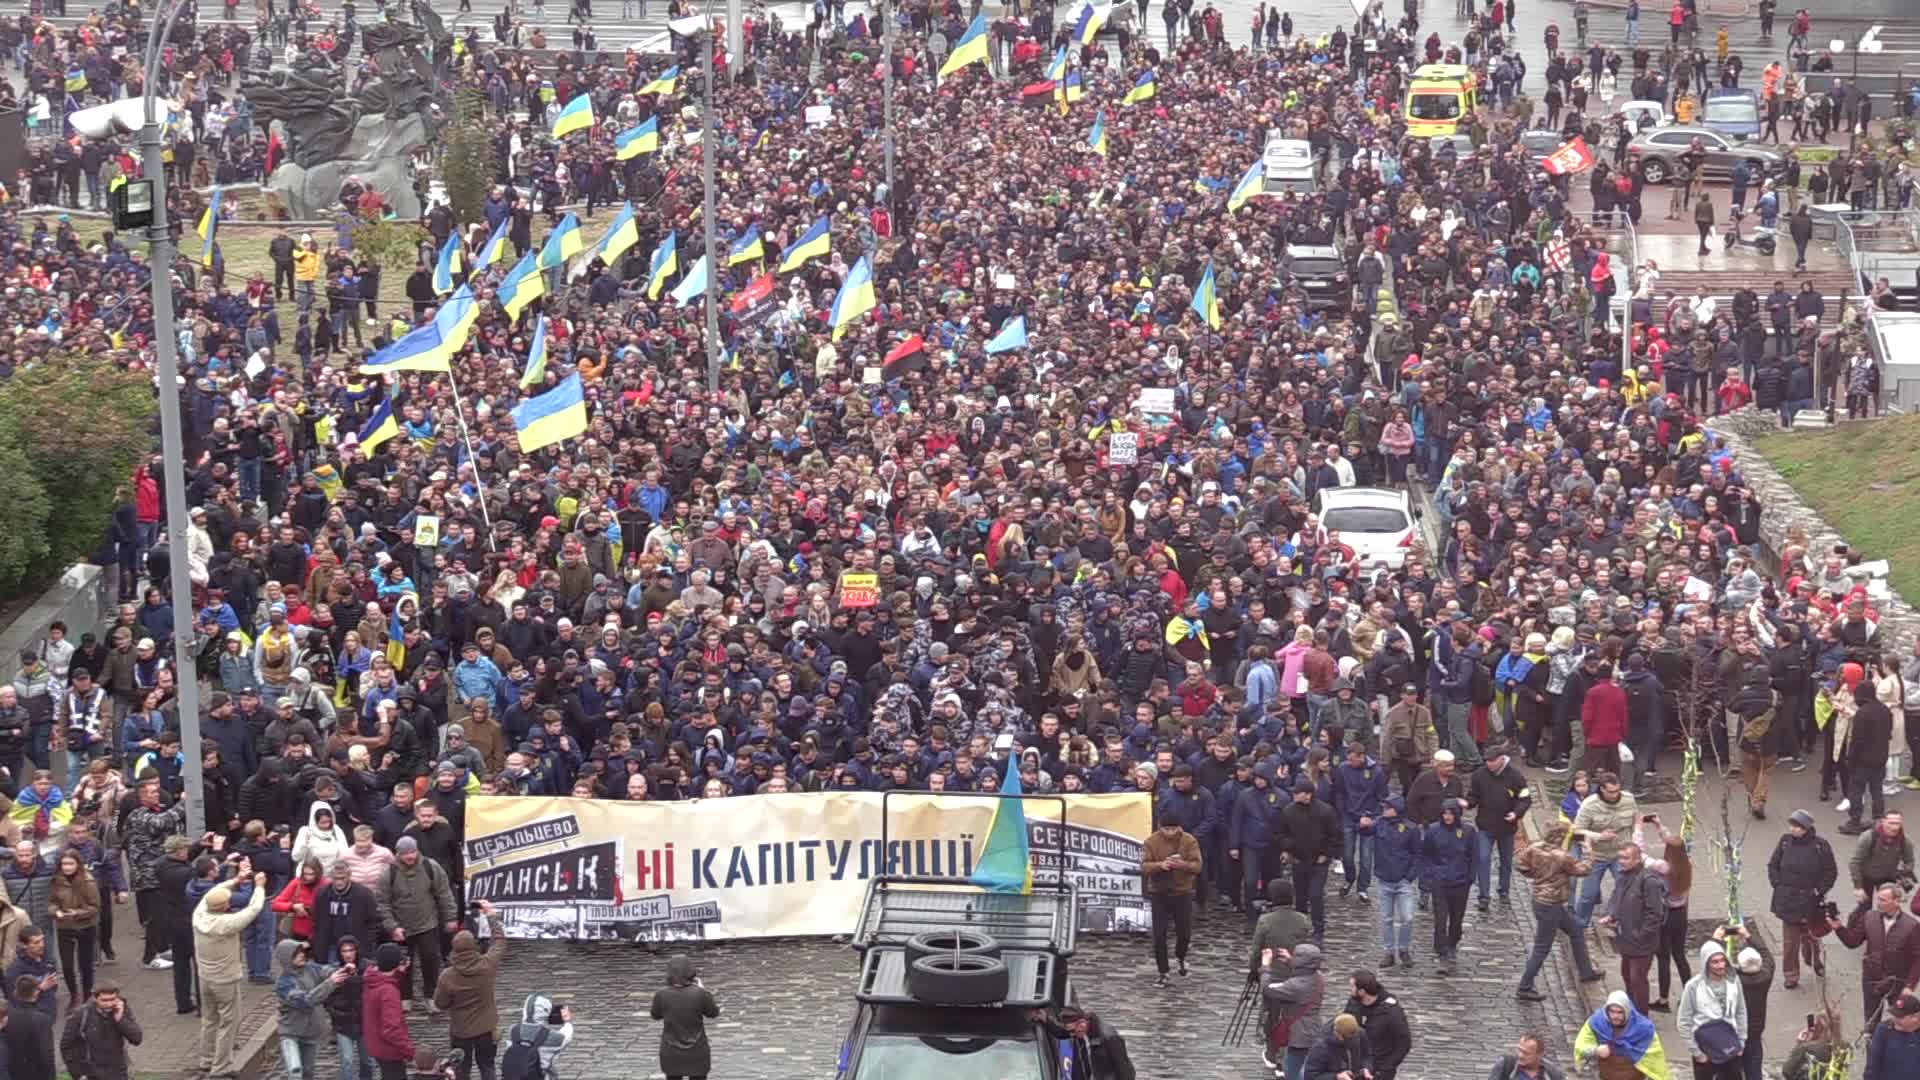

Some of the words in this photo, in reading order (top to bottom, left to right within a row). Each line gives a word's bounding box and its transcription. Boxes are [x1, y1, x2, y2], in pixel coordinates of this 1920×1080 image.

[474, 820, 573, 857] ДЕБАЛЬЦЕВО
[473, 855, 600, 898] ЛУГАНСЬК
[636, 843, 675, 890] НІ
[692, 833, 974, 890] КАПІТУЛЯЦІЇ
